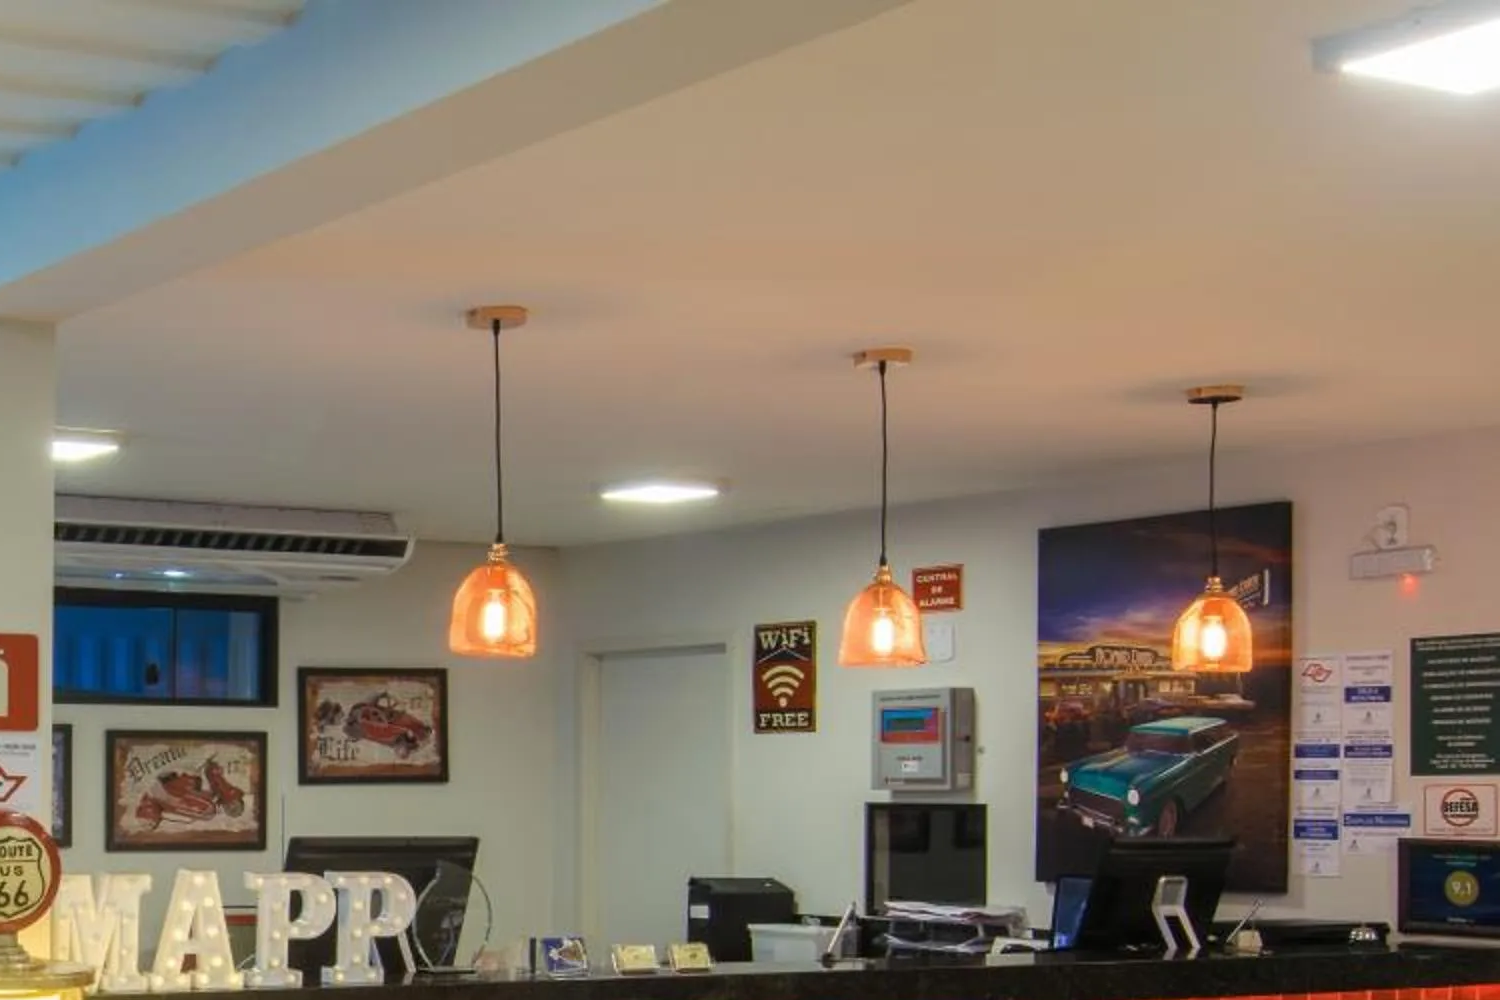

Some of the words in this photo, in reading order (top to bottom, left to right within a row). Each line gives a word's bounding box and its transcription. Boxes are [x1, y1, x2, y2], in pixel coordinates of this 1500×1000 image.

[760, 713, 809, 727] FREE
[0, 865, 25, 877] US
[51, 868, 417, 994] MAPP
